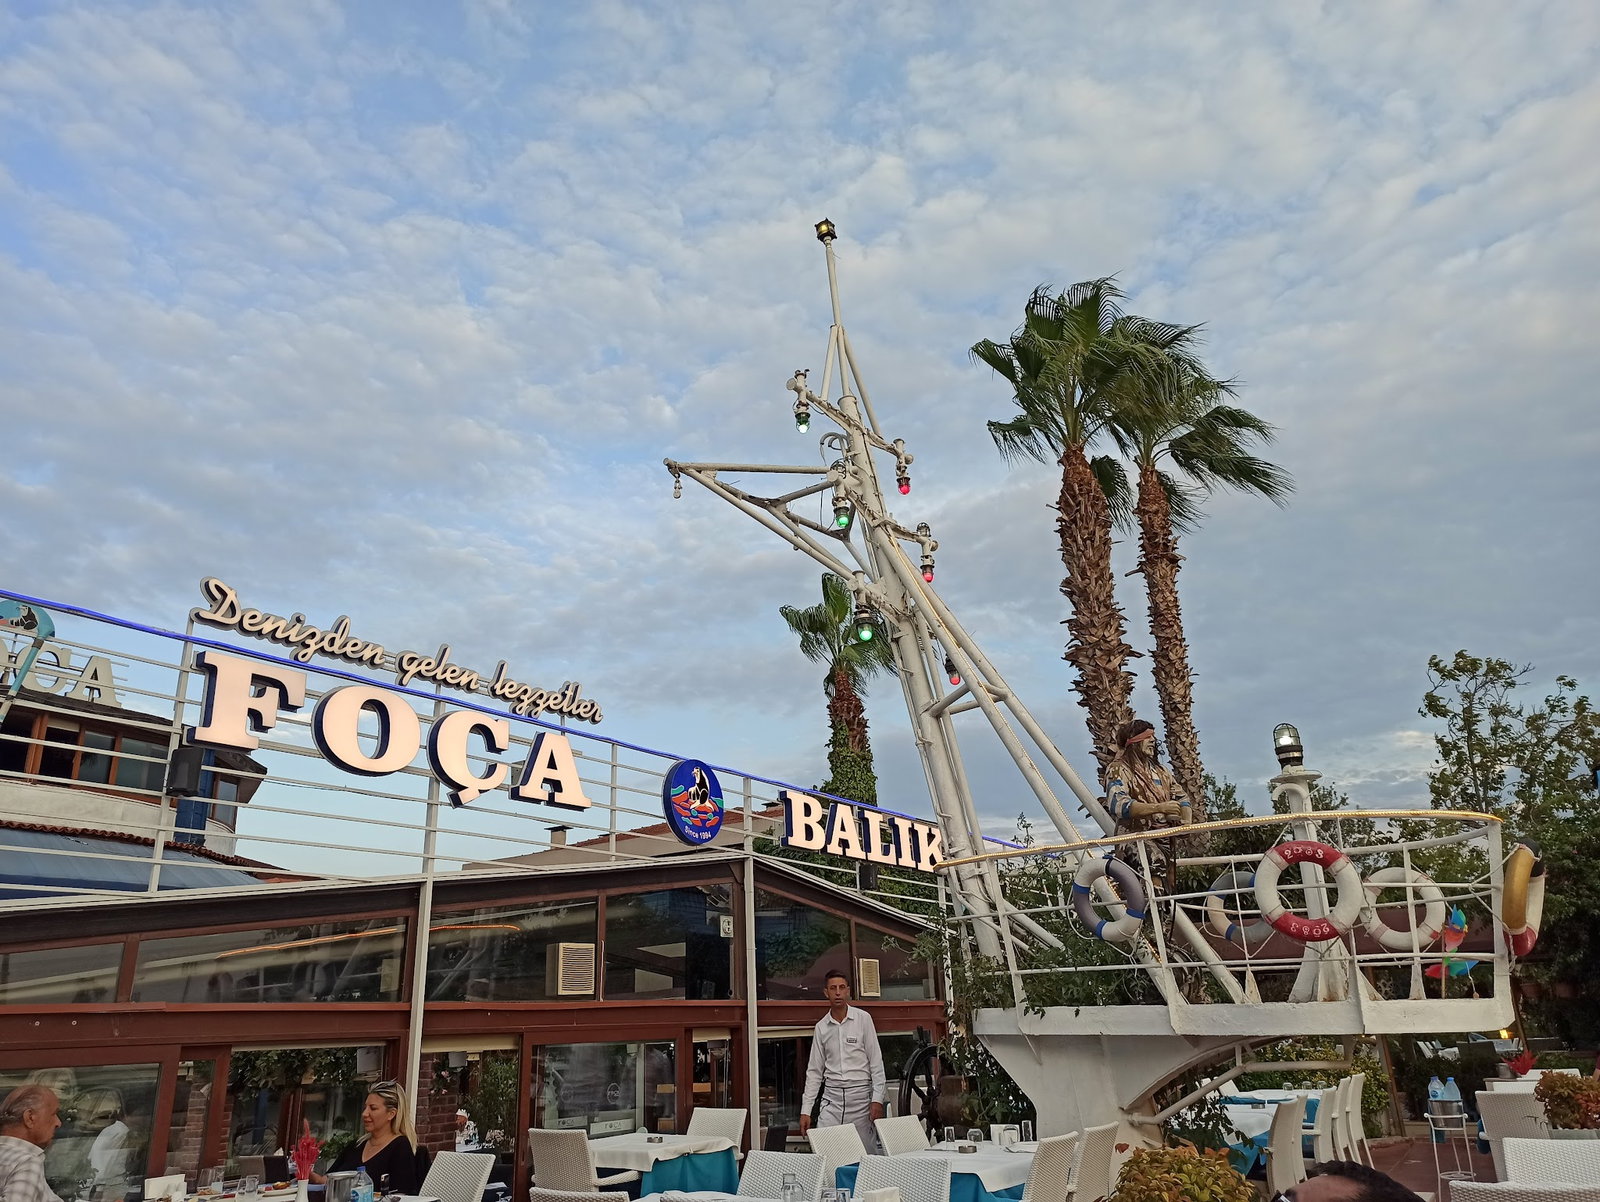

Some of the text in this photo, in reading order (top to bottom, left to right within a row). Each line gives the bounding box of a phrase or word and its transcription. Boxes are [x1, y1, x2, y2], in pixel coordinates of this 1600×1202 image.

[194, 577, 603, 721] Denizden gelen lezzetler
[188, 650, 592, 809] FOÇA
